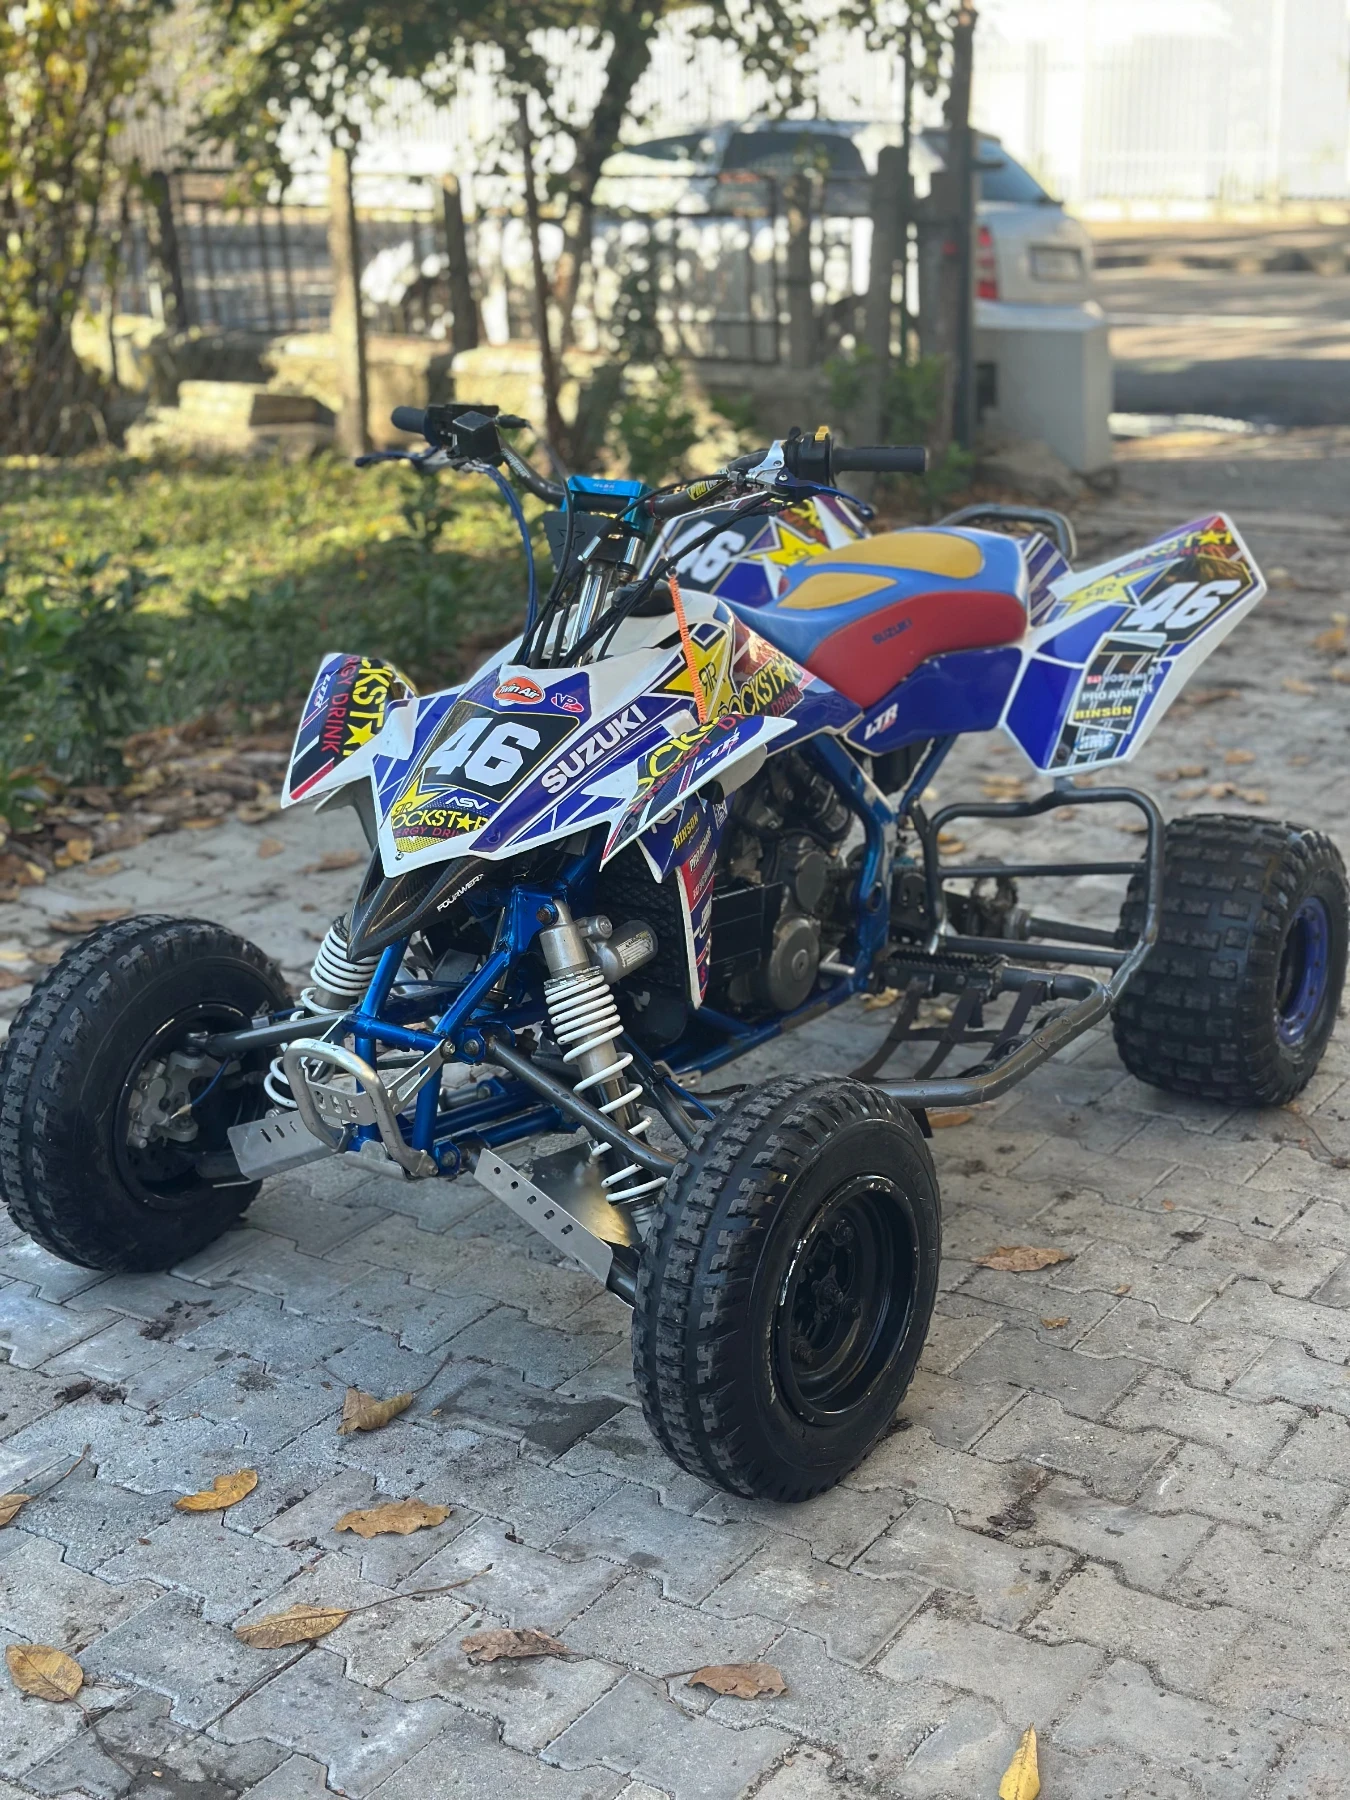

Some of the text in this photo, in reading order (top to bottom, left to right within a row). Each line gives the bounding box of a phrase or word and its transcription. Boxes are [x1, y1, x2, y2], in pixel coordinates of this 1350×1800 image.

[1121, 579, 1242, 631] 46
[872, 617, 913, 645] SUZUKI
[519, 687, 540, 699] Air
[555, 692, 578, 709] VP
[1082, 683, 1154, 702] PRO ARMOR
[321, 693, 349, 754] DRINK
[863, 703, 898, 741] LTR
[1074, 705, 1133, 720] HINSON
[421, 717, 541, 787] 46
[541, 704, 647, 795] SUZUKI
[445, 796, 490, 810] ASV
